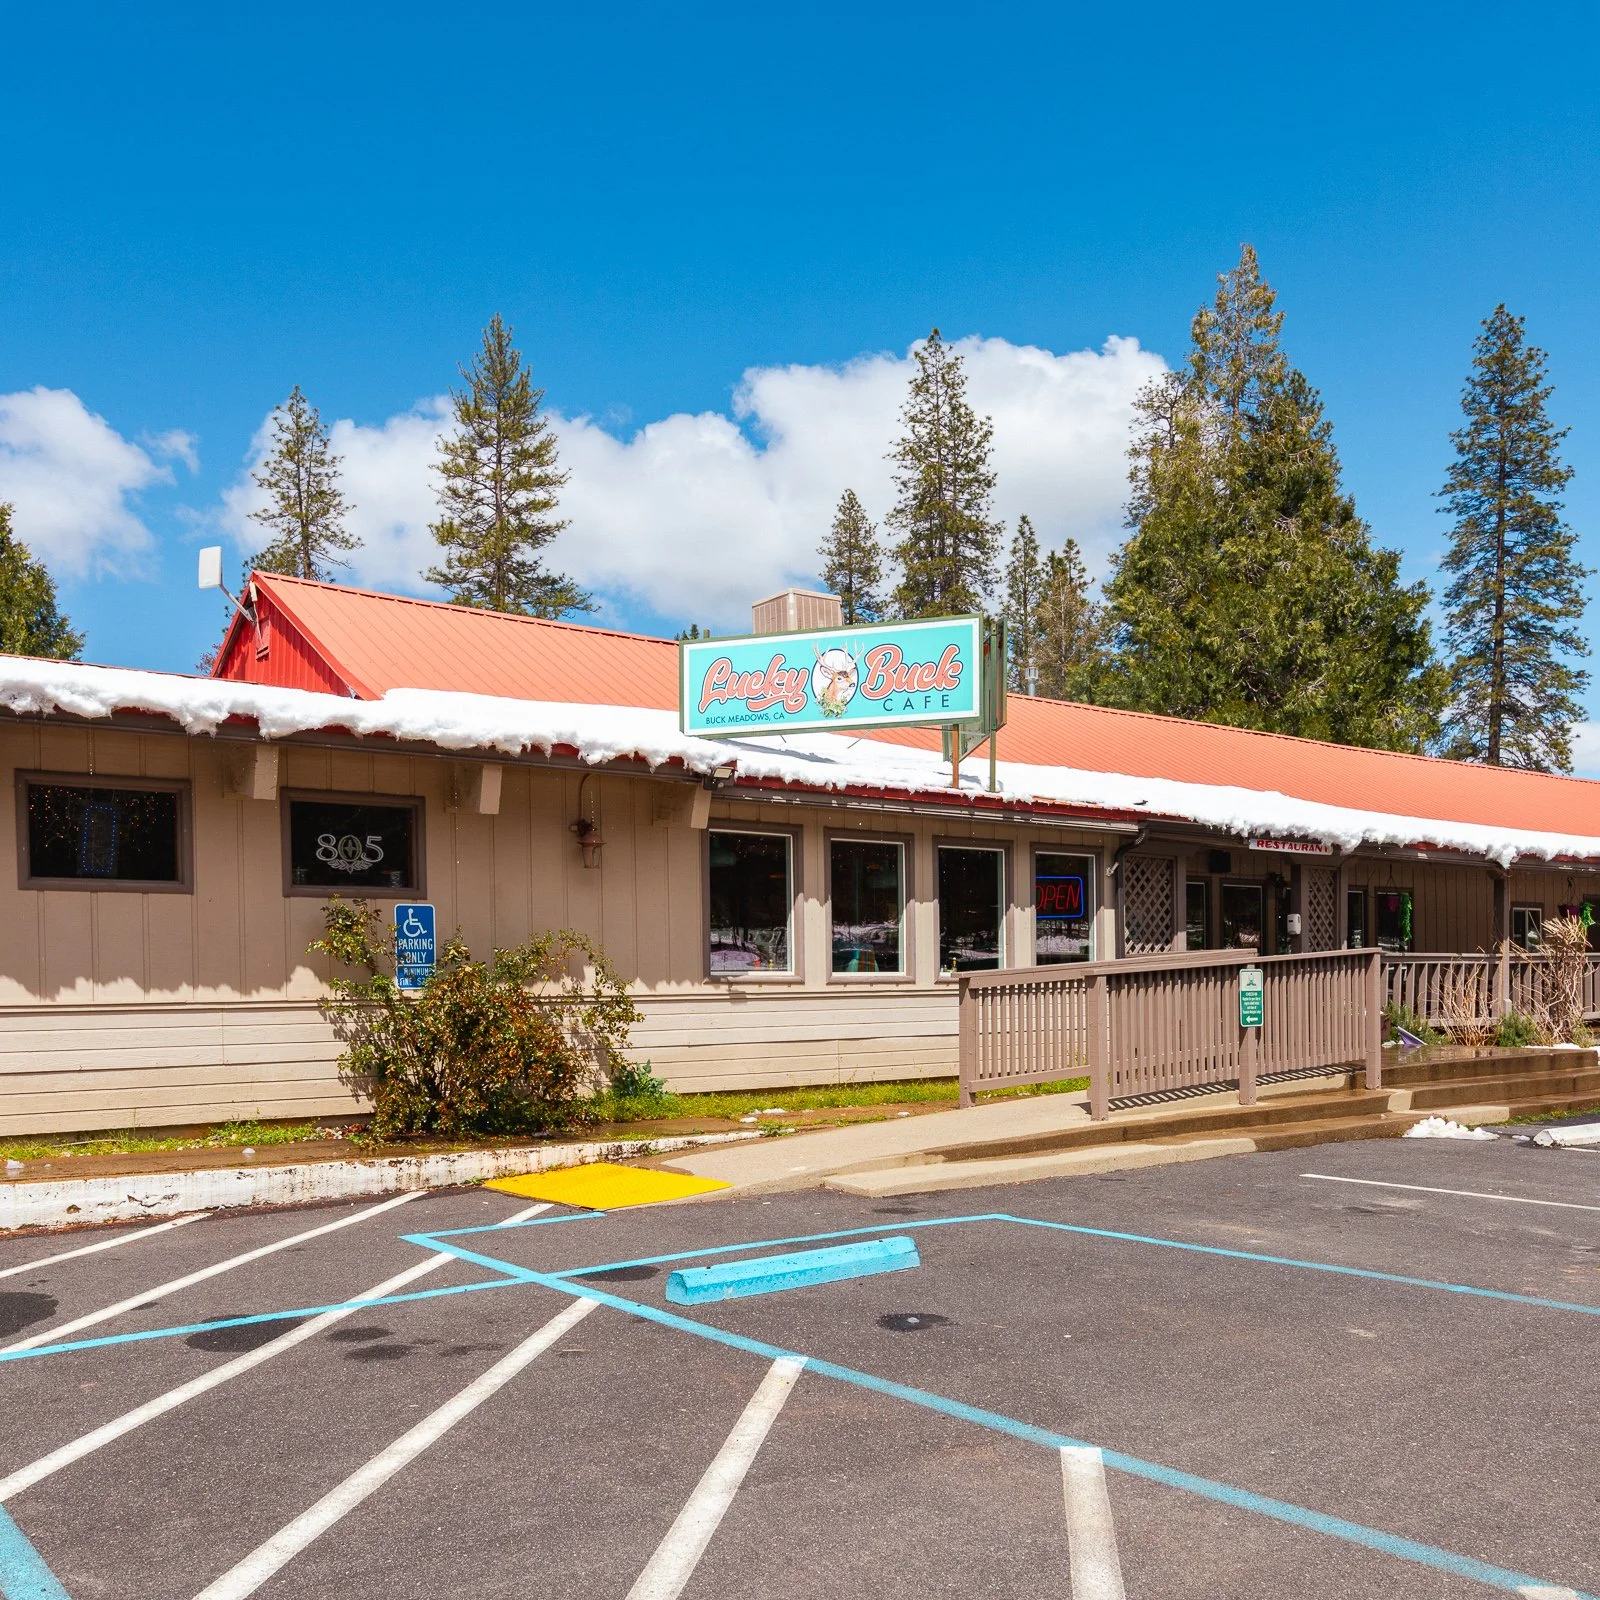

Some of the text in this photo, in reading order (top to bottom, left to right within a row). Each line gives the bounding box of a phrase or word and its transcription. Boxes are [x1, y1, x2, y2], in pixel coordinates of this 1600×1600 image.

[698, 643, 963, 713] Lucky Buck
[883, 694, 950, 712] CAFE
[705, 712, 785, 725] BUCK MEADOWS, CA
[316, 833, 384, 863] 805
[1256, 839, 1328, 852] RESTAURANT
[398, 938, 433, 950] PARKING
[405, 951, 427, 963] ONLY
